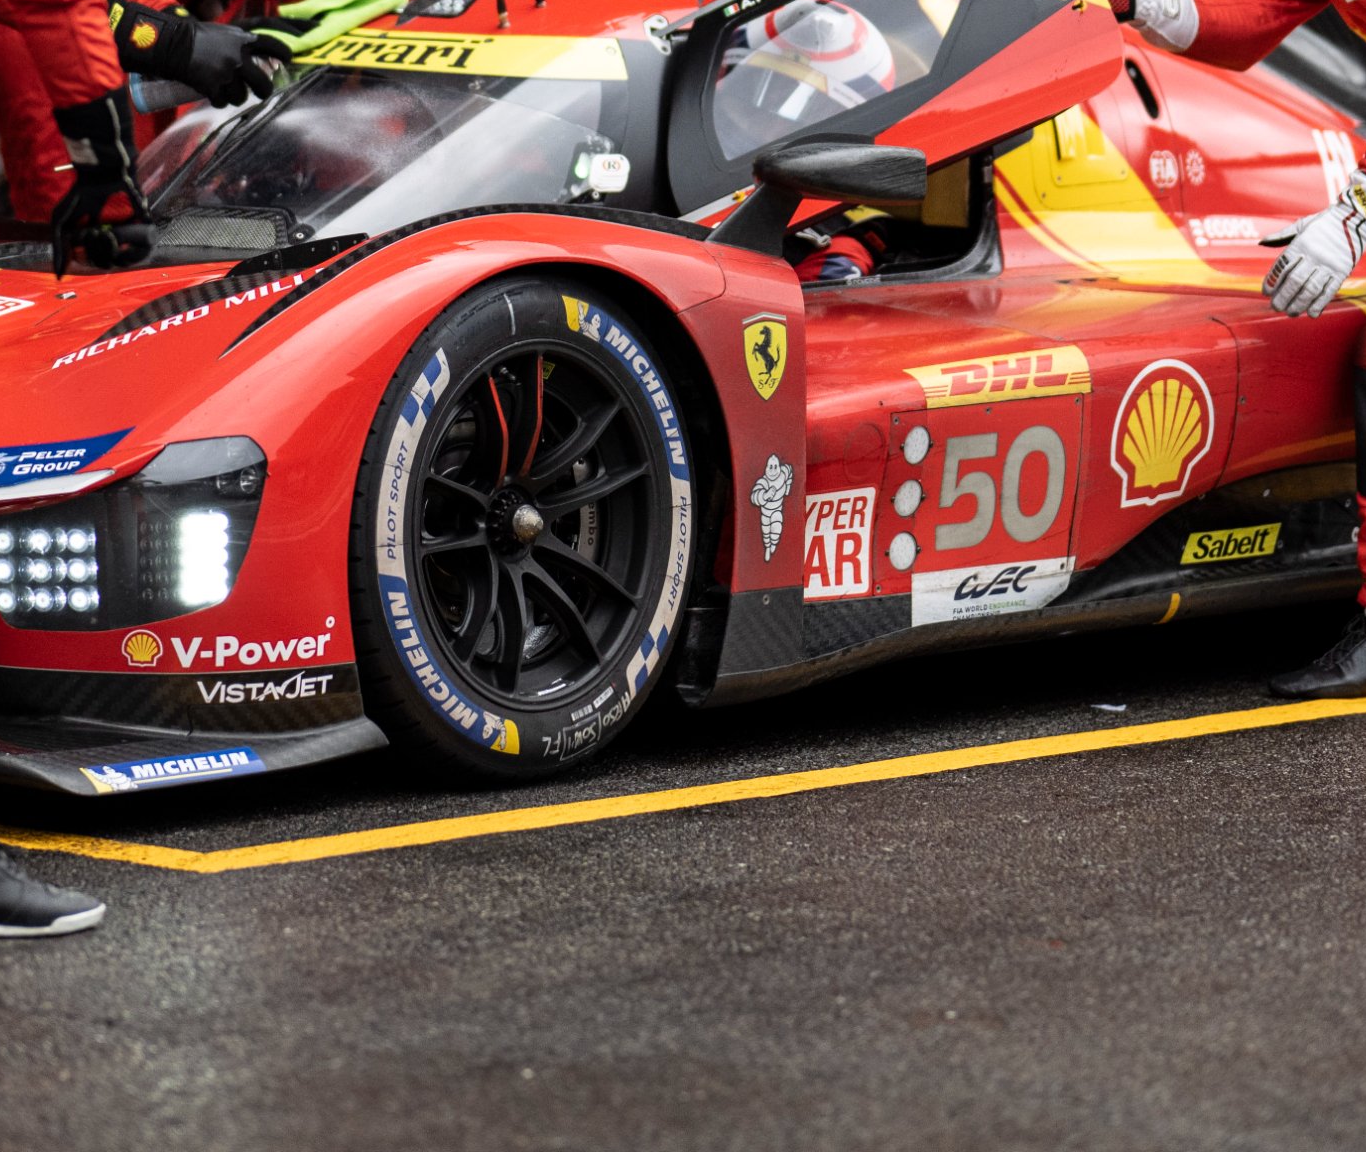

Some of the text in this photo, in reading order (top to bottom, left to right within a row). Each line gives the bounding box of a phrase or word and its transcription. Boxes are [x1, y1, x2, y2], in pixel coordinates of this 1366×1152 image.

[315, 32, 494, 69] rrari
[1150, 158, 1178, 178] FIA
[51, 267, 325, 370] RICHARD MILL
[942, 355, 1069, 397] DHL
[604, 325, 686, 466] MICHELIN
[12, 460, 81, 476] GROUP
[18, 448, 87, 463] PELZER
[387, 441, 408, 560] PILOT SPORT
[935, 425, 1067, 551] 50
[587, 502, 596, 547] embo
[804, 495, 868, 533] YPER
[667, 495, 688, 611] PILOT SPORT
[804, 532, 864, 589] AR
[1192, 524, 1273, 562] Sabelt
[953, 565, 1037, 601] WEC
[952, 598, 1027, 615] FIA WORLD ENDURANCE
[170, 633, 331, 668] V-Power
[388, 591, 479, 731] MICHELIN
[197, 671, 334, 704] VISTAJET
[541, 730, 561, 757] FL
[130, 751, 250, 780] MICHELIN
